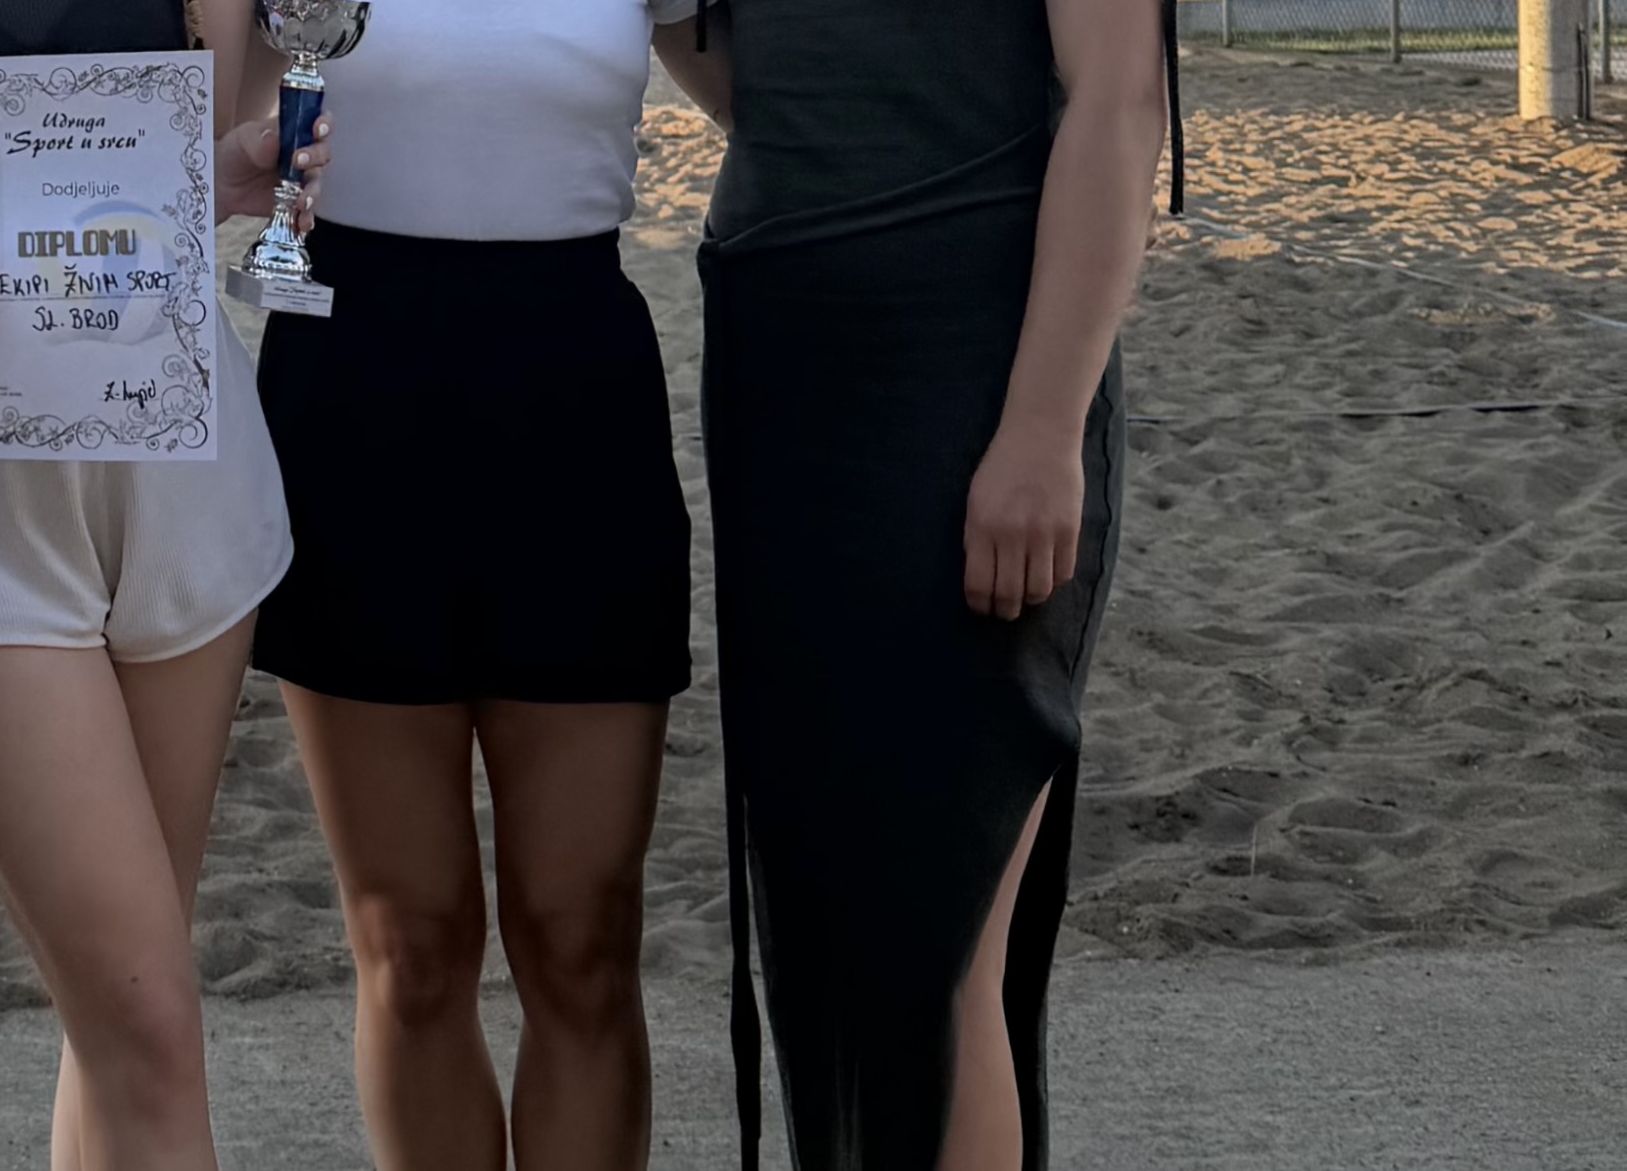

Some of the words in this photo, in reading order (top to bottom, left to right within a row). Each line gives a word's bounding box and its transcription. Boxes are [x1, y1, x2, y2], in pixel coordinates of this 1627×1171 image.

[42, 112, 106, 133] Udruga
[5, 130, 74, 158] "Sport
[80, 137, 92, 149] u
[98, 129, 146, 149] srcu"
[42, 181, 121, 198] Dodjeljuje
[18, 229, 137, 258] DIPLOMU
[126, 270, 177, 292] SPORT
[69, 308, 119, 331] BROD
